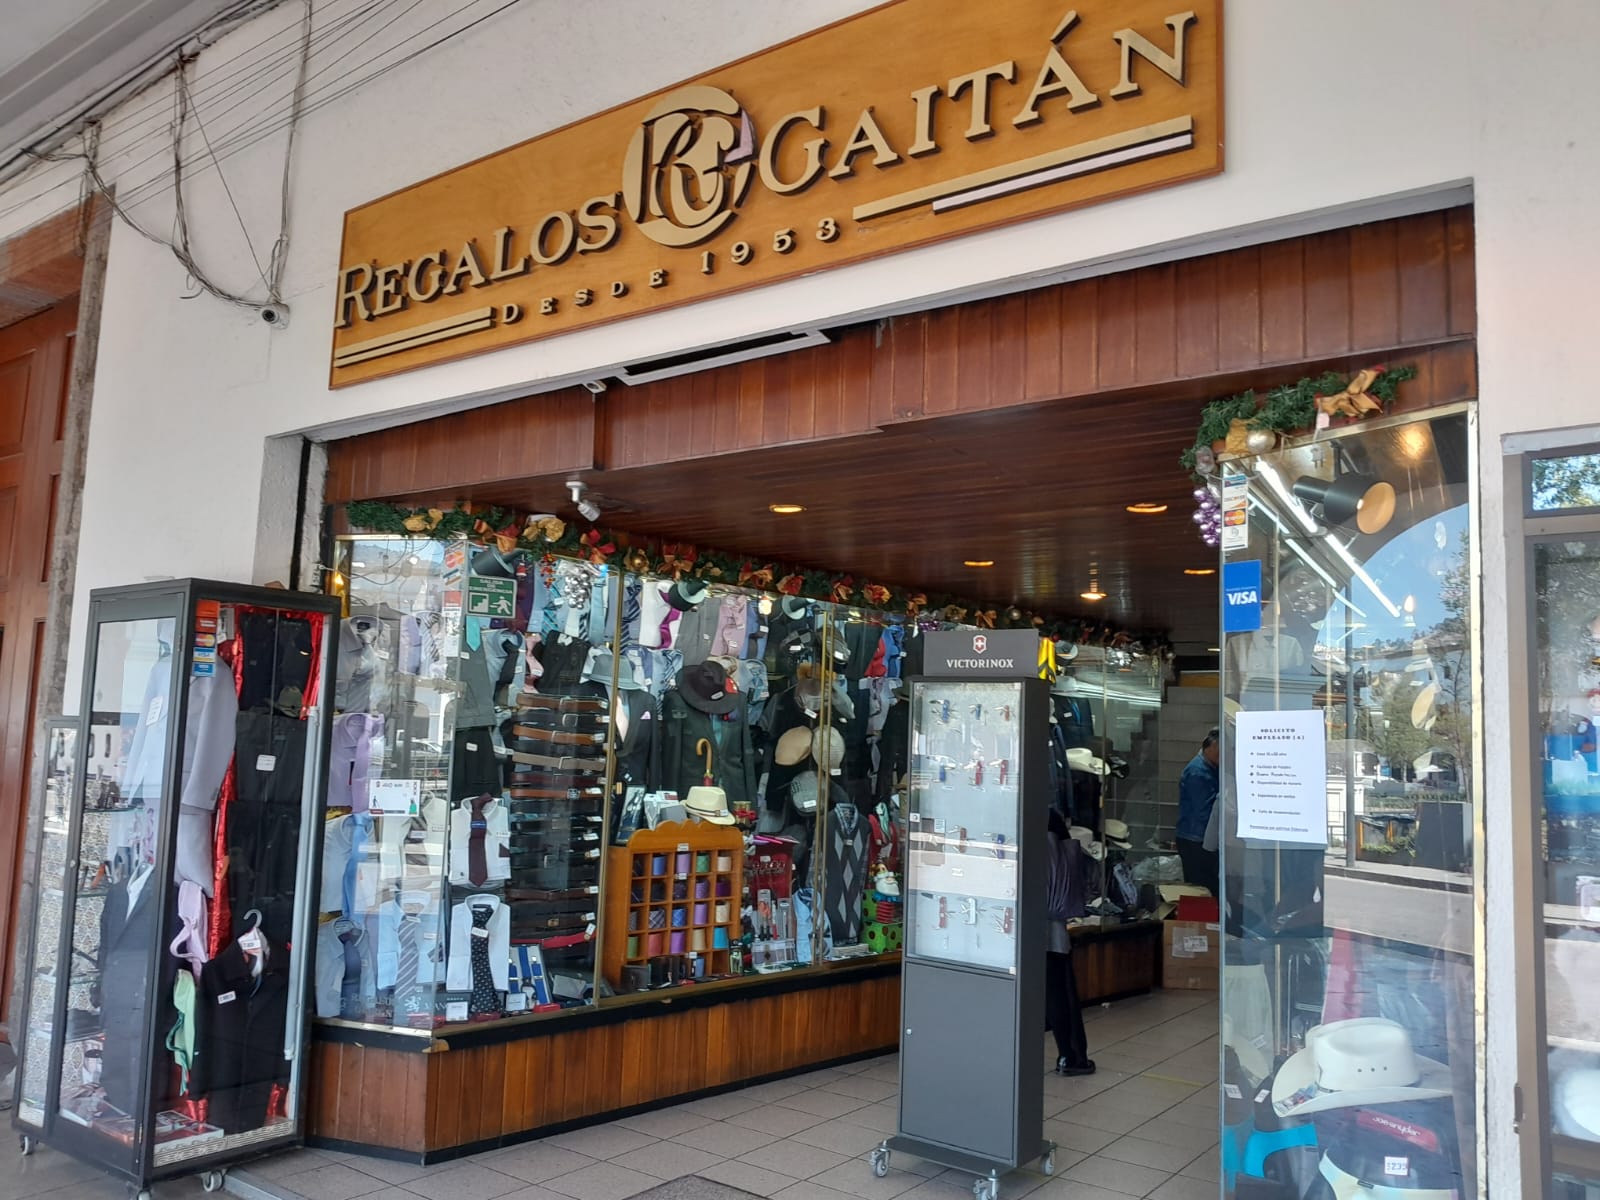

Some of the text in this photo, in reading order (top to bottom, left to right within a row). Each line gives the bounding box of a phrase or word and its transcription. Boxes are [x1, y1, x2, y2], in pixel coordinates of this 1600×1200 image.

[334, 191, 622, 328] REGALOS
[759, 9, 1198, 195] GAITÁN
[501, 217, 840, 324] DESDE 1953
[1226, 591, 1258, 605] VISA
[946, 658, 1014, 669] VICTORINOX
